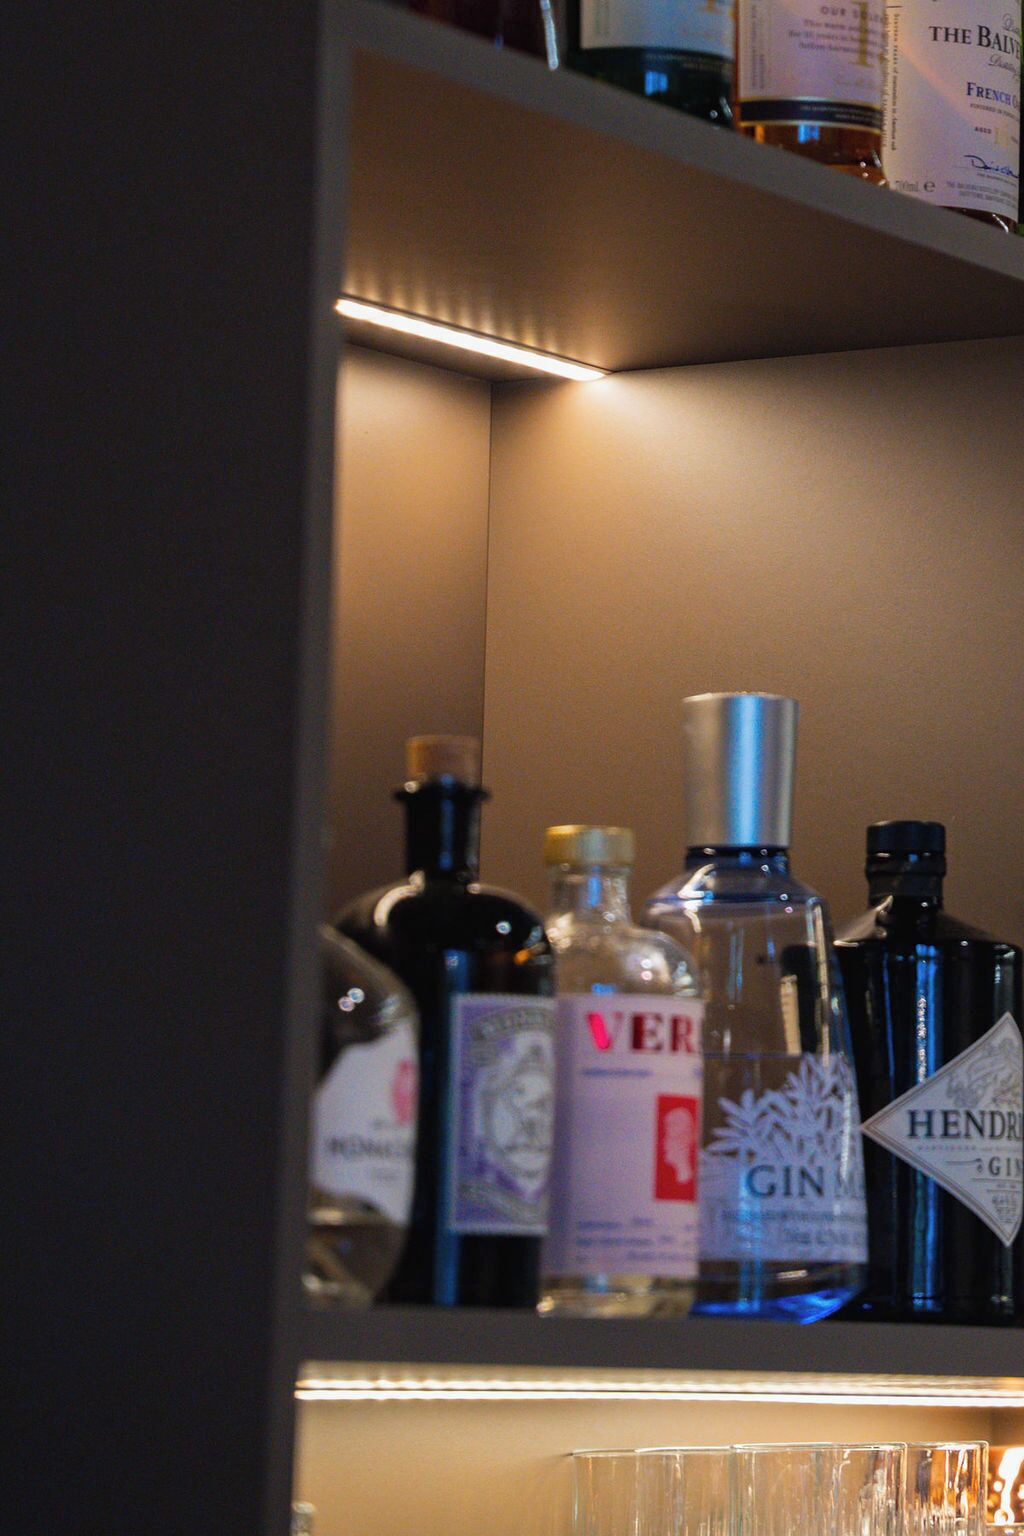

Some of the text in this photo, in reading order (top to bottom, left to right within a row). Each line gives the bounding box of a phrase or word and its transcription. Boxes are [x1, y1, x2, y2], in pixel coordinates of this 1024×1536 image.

[929, 25, 972, 45] THE
[966, 81, 1011, 106] FRENCH
[747, 1164, 824, 1198] GIN
